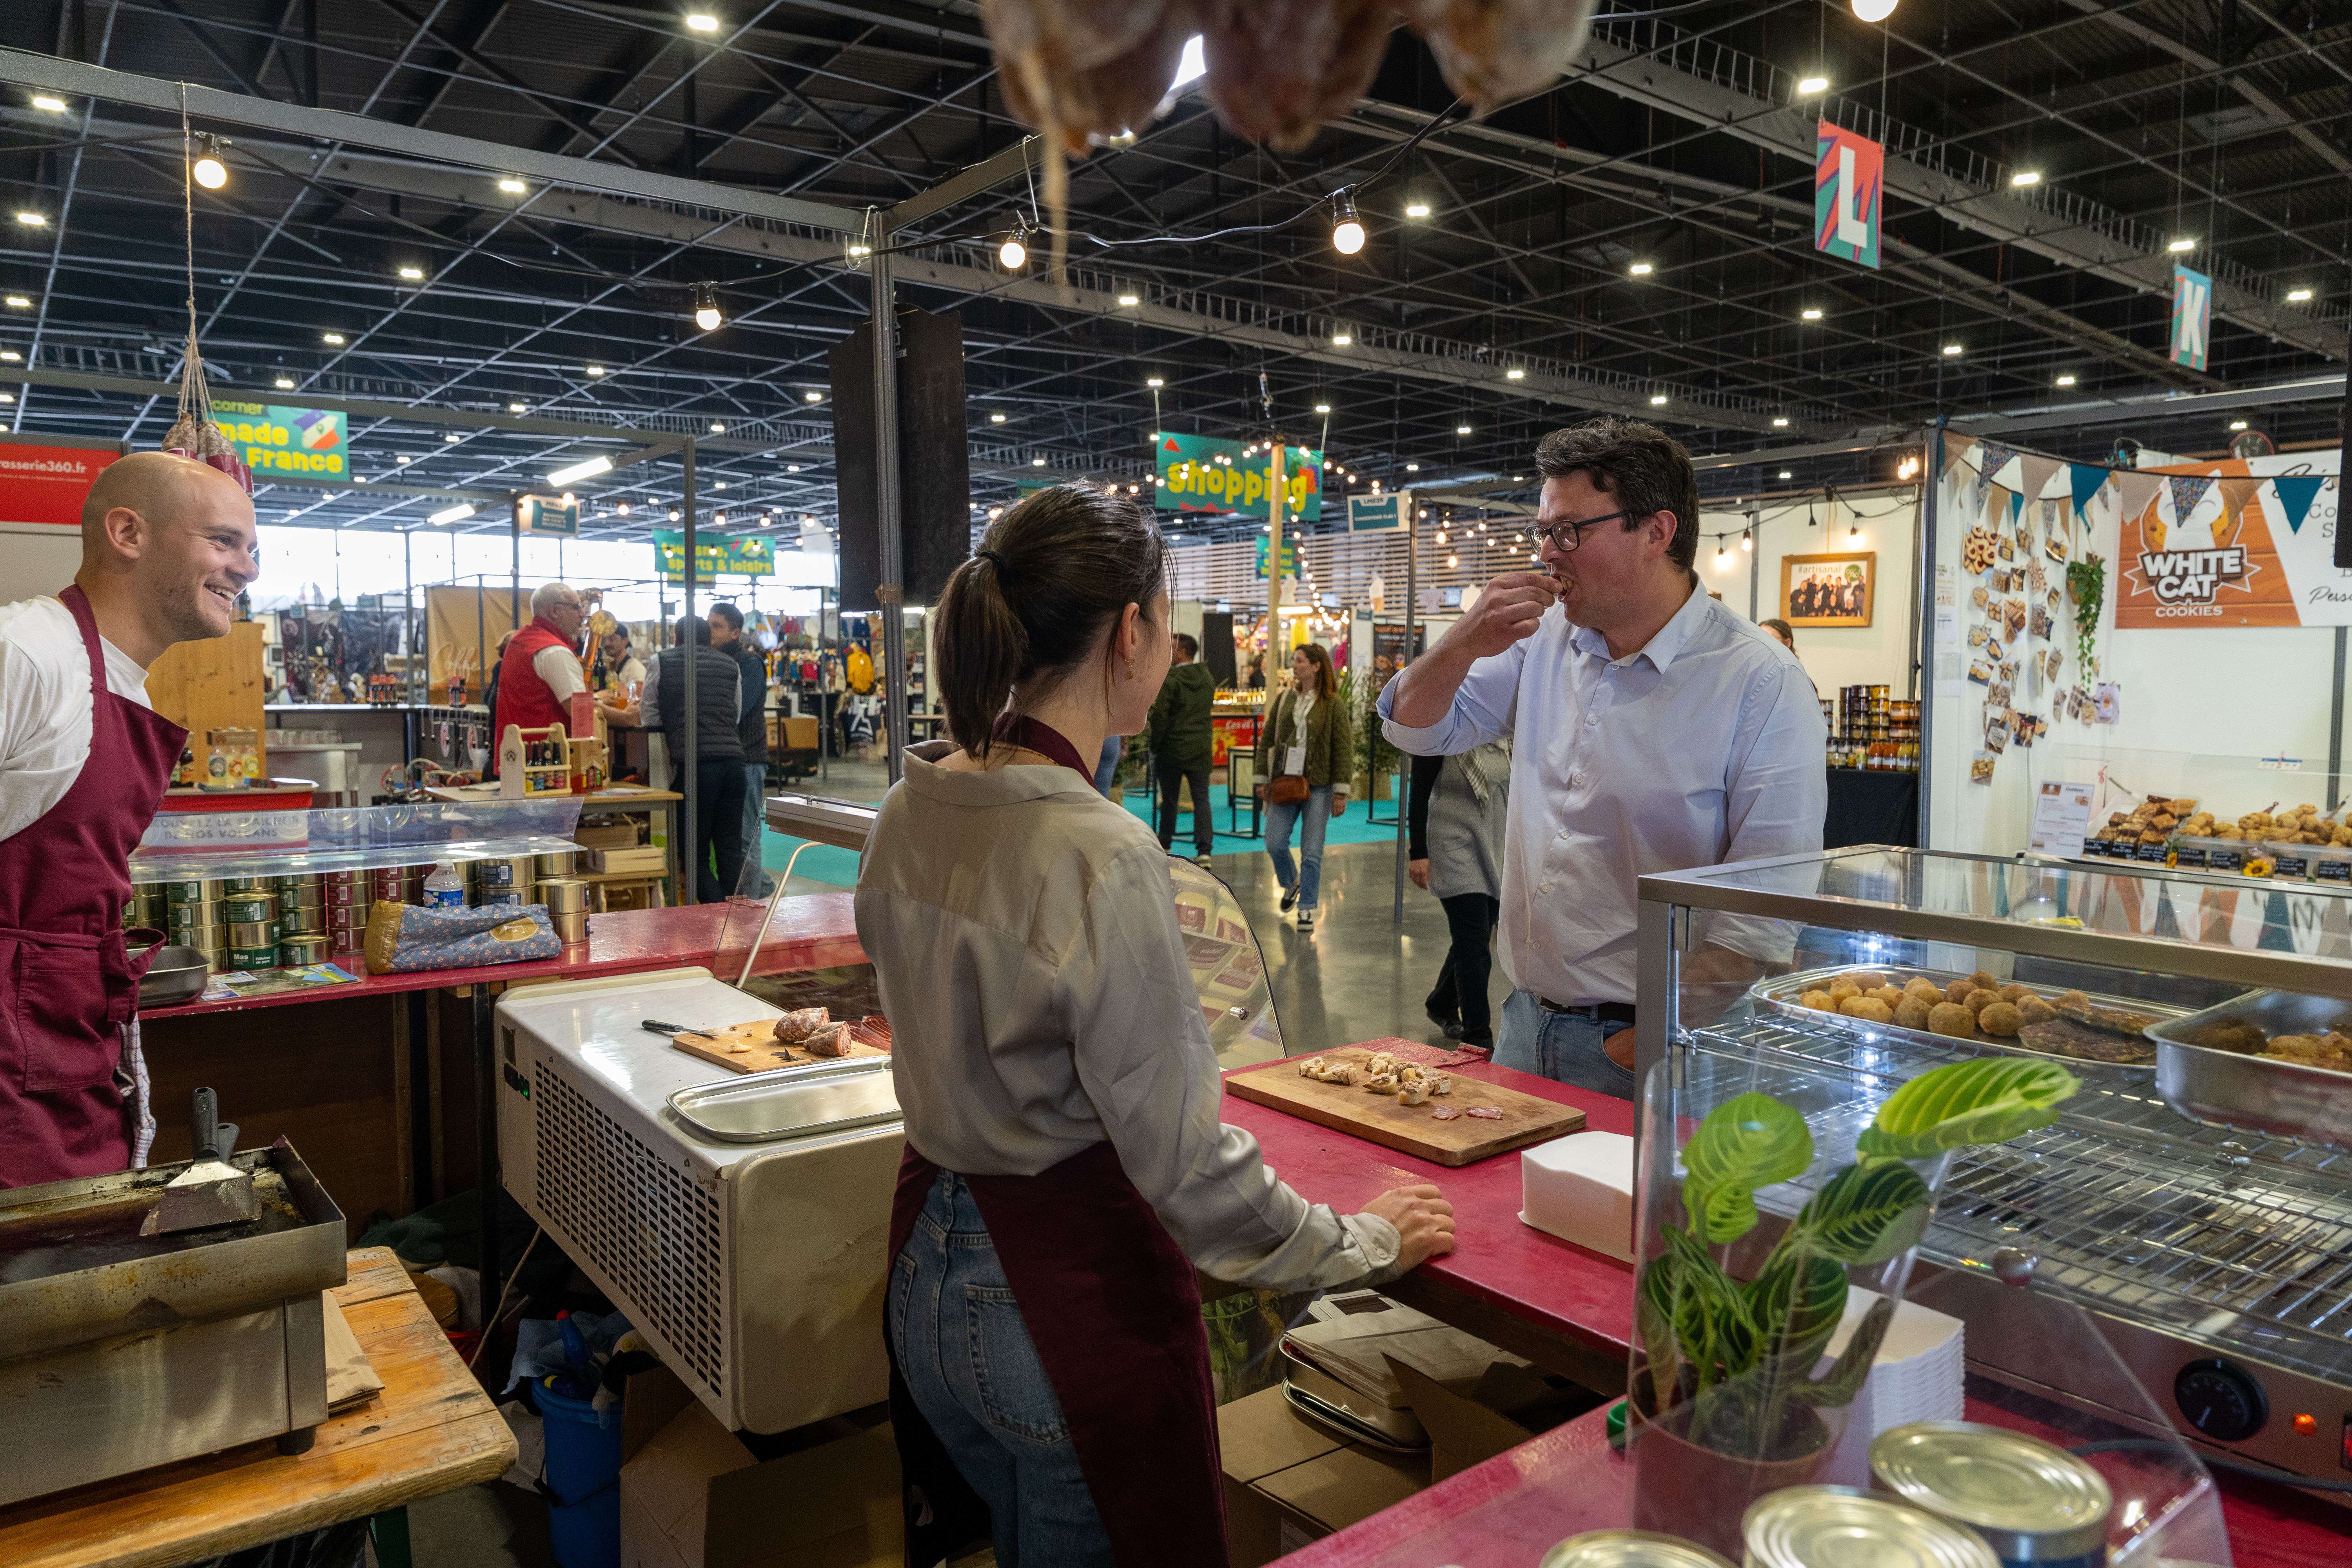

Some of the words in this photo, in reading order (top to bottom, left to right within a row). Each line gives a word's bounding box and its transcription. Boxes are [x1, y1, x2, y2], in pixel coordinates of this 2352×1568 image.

[1838, 145, 1867, 249] L
[2181, 279, 2205, 356] K
[211, 400, 263, 415] corner
[247, 446, 343, 473] France
[1798, 564, 1841, 573] #artisanal
[2143, 550, 2241, 577] WHITE
[2157, 574, 2217, 598] CAT
[2155, 606, 2223, 617] COOKIES
